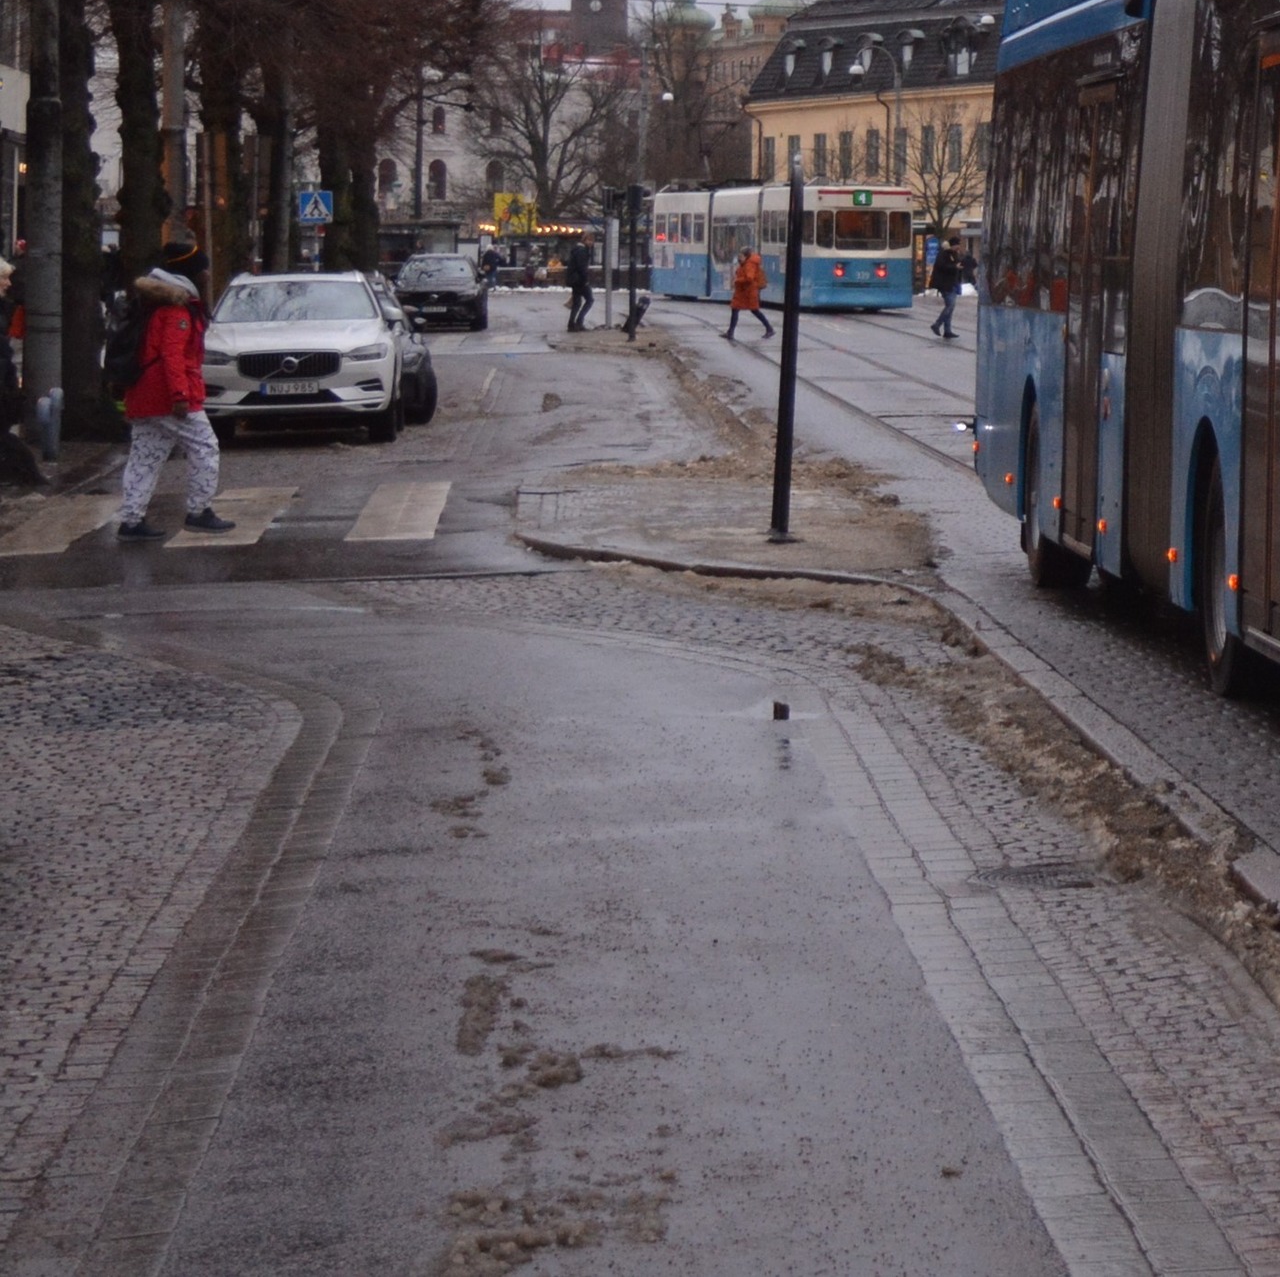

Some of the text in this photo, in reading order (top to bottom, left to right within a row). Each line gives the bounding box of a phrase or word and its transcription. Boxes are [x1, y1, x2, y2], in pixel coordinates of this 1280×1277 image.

[857, 192, 866, 205] 4
[270, 382, 314, 394] NUJ 985
